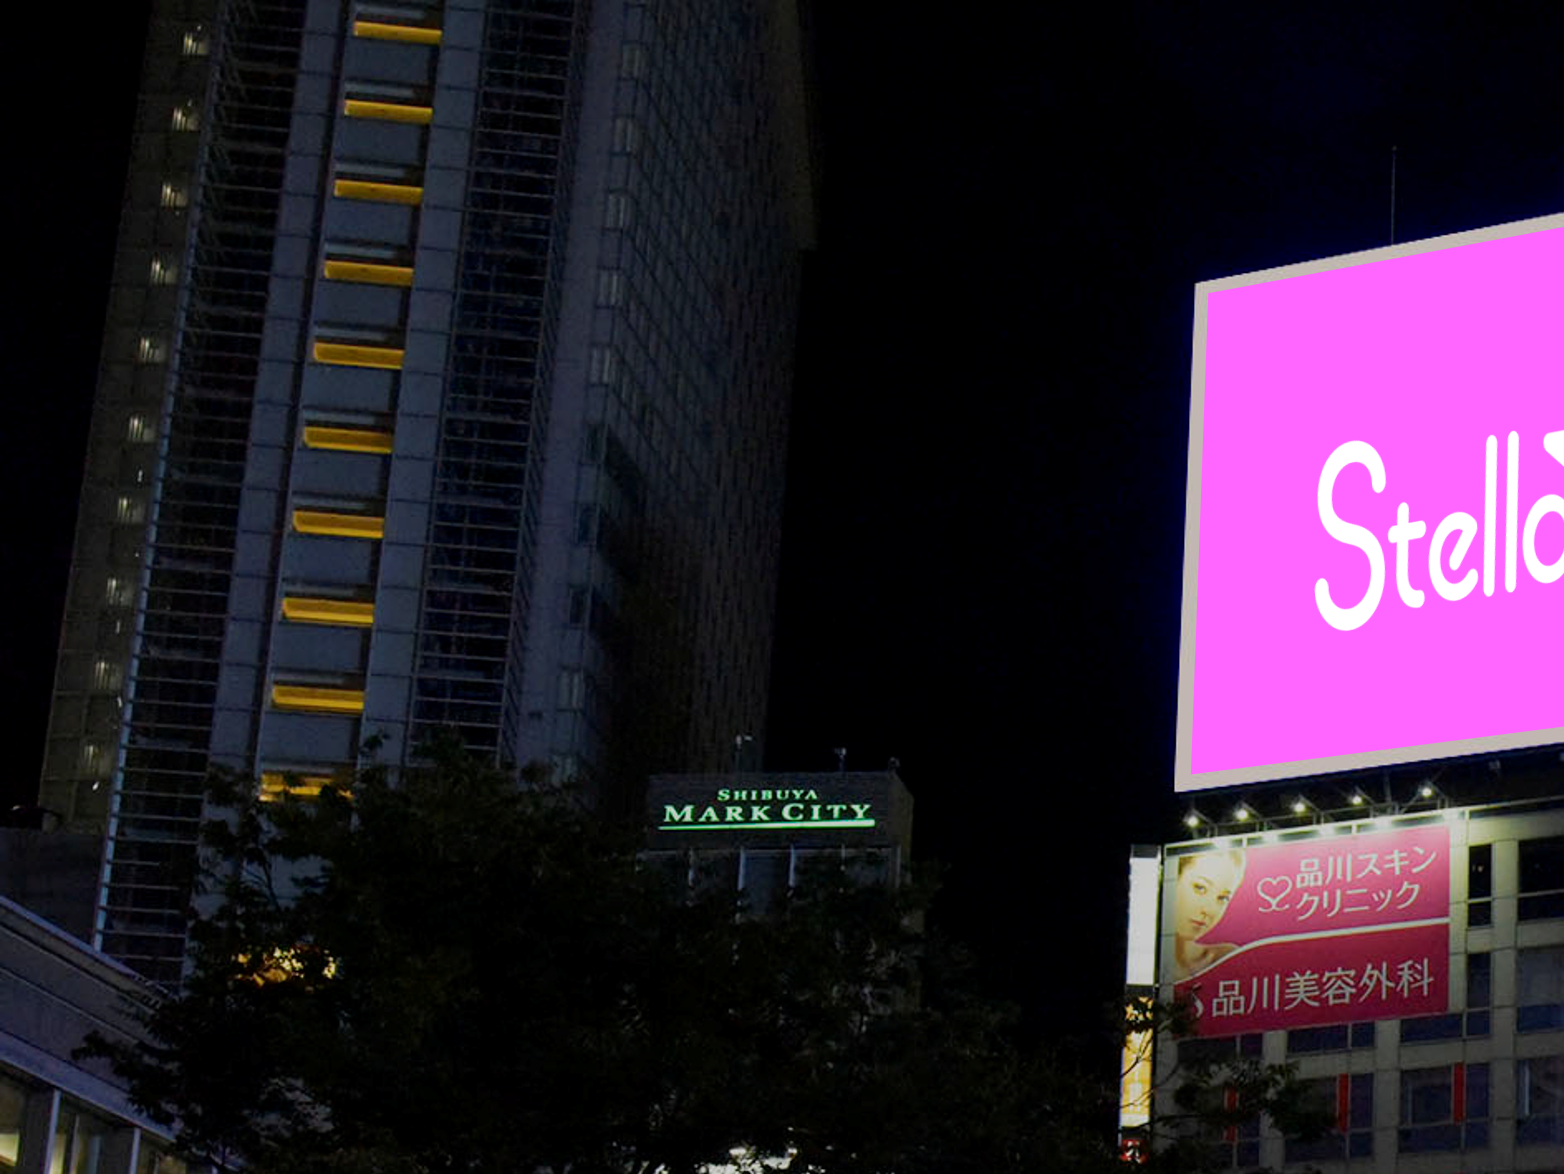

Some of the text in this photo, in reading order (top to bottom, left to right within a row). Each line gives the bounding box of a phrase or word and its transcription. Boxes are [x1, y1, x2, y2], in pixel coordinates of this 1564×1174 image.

[663, 803, 872, 822] MARK CITY
[718, 789, 818, 801] SHIBUYA
[1295, 847, 1438, 890] 品川スキン
[1295, 880, 1421, 922] クリニック
[1211, 956, 1435, 1018] 品川美容外科
